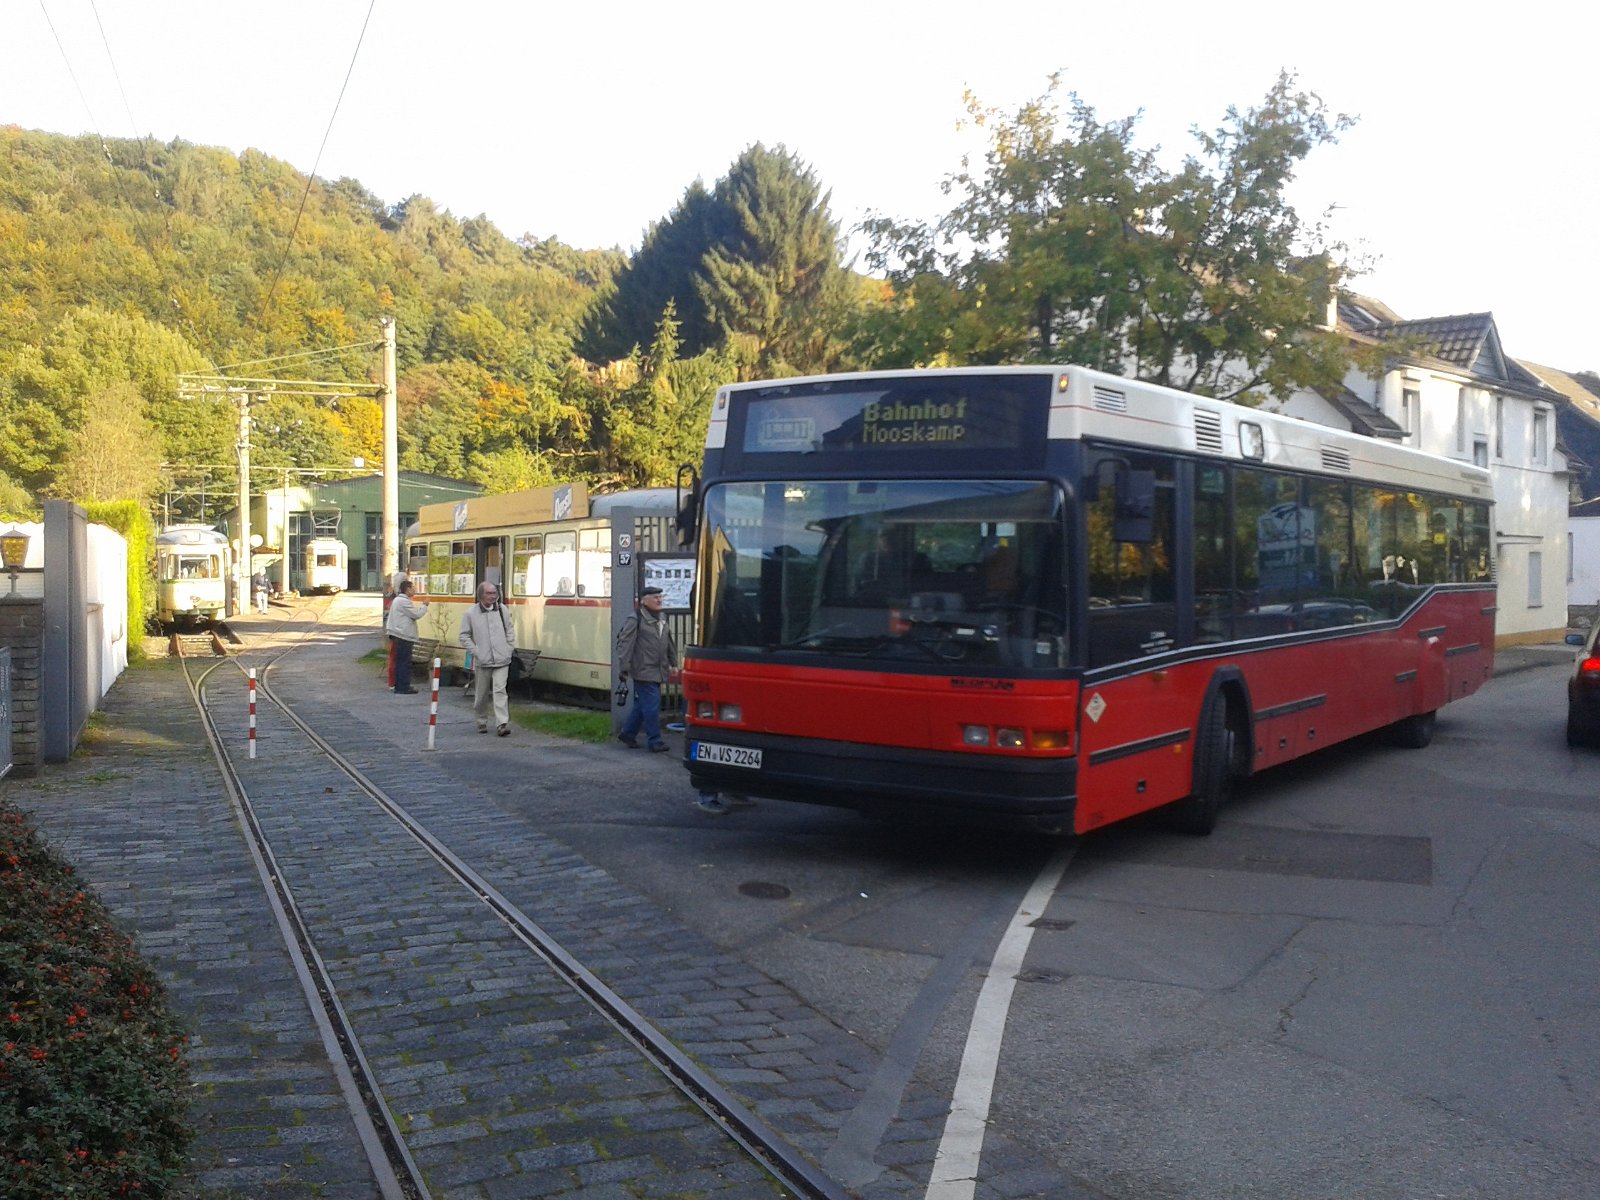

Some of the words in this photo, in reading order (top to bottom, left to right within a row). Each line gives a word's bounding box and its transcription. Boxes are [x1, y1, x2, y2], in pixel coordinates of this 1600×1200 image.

[863, 398, 967, 422] Bahnhof
[863, 422, 966, 443] Mooskamp
[619, 553, 631, 565] 57
[698, 744, 712, 760] EN
[719, 746, 732, 763] VS
[734, 749, 761, 767] 2264
